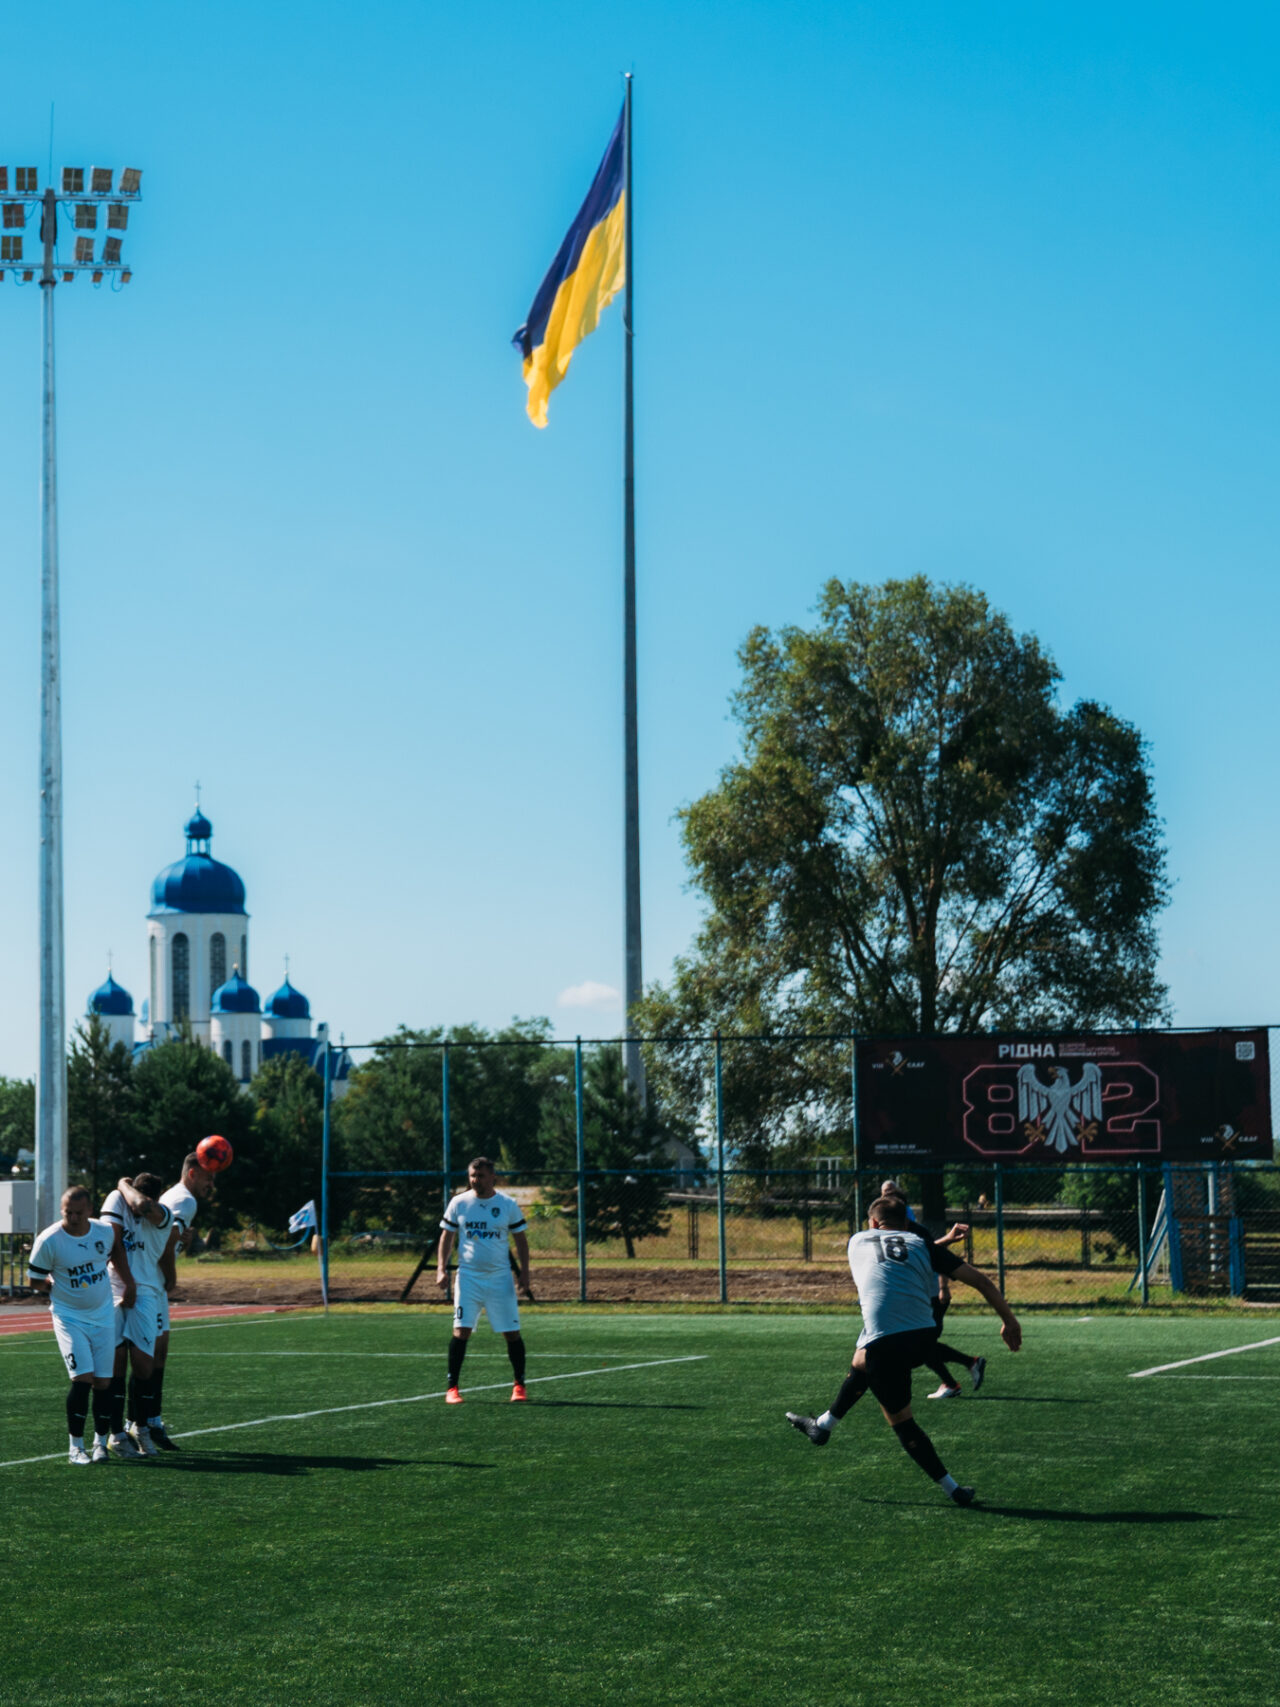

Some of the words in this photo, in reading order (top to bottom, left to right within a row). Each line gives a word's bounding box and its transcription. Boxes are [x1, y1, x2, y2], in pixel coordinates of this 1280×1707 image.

[998, 1043, 1056, 1059] РІДНА
[465, 1220, 488, 1230] МХП
[67, 1262, 95, 1278] МХП
